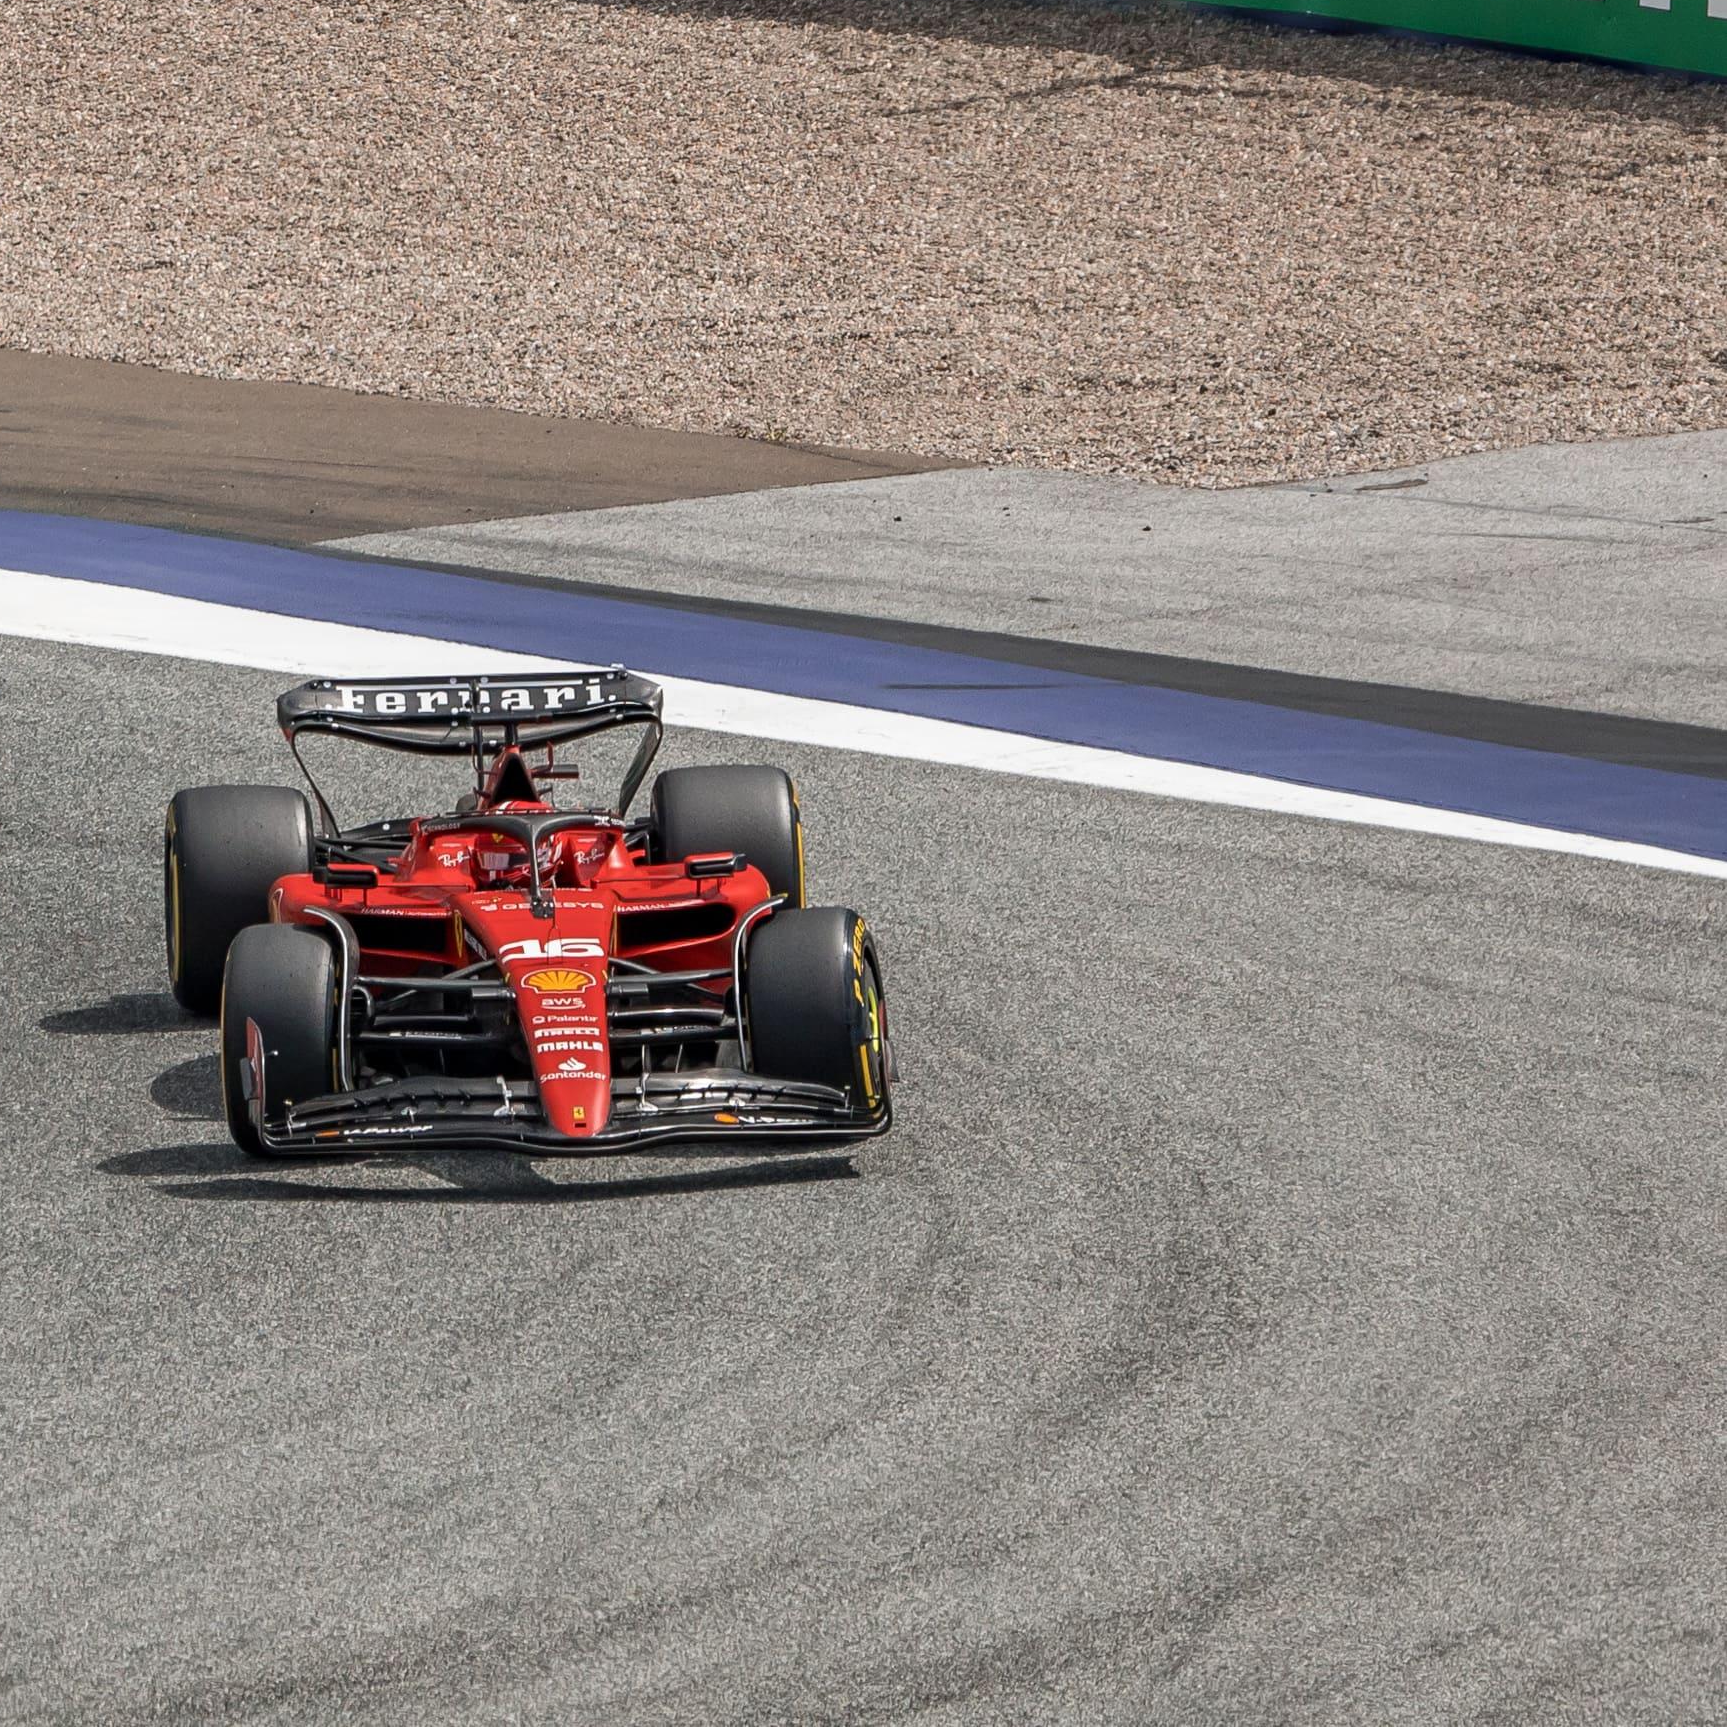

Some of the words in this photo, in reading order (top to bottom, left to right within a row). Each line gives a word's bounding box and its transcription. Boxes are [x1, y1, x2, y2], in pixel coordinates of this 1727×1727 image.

[336, 678, 607, 714] Ferrari
[499, 937, 604, 964] 16
[852, 917, 866, 977] ZERO
[542, 997, 583, 1006] aws
[853, 978, 865, 1008] P
[547, 1015, 599, 1023] Palantir
[537, 1040, 604, 1054] MAHLE
[540, 1071, 606, 1084] Santander
